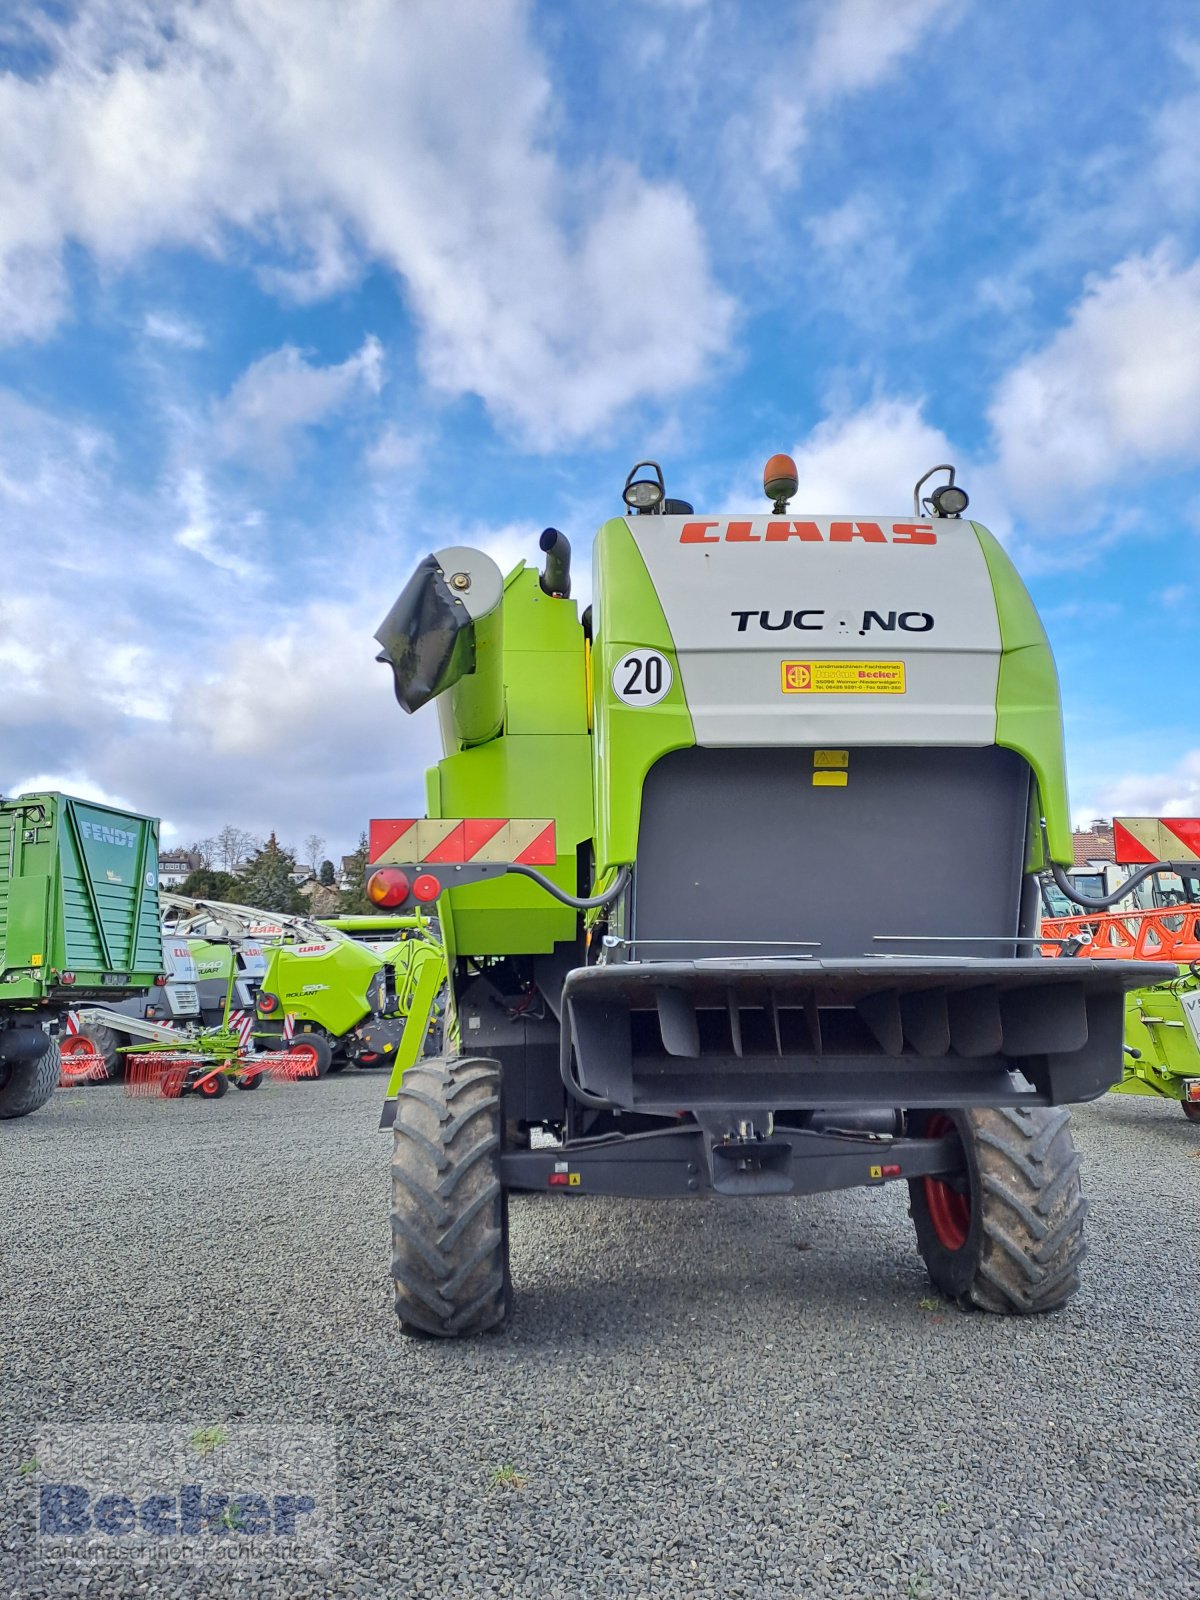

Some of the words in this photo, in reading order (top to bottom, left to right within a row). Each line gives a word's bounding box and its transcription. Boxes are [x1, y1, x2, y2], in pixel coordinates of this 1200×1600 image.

[679, 521, 938, 545] CLAAS
[731, 610, 935, 632] TUCNO
[623, 656, 662, 695] 20
[858, 671, 898, 679] Becker
[80, 820, 137, 848] FENDT
[298, 945, 326, 953] CLAAS
